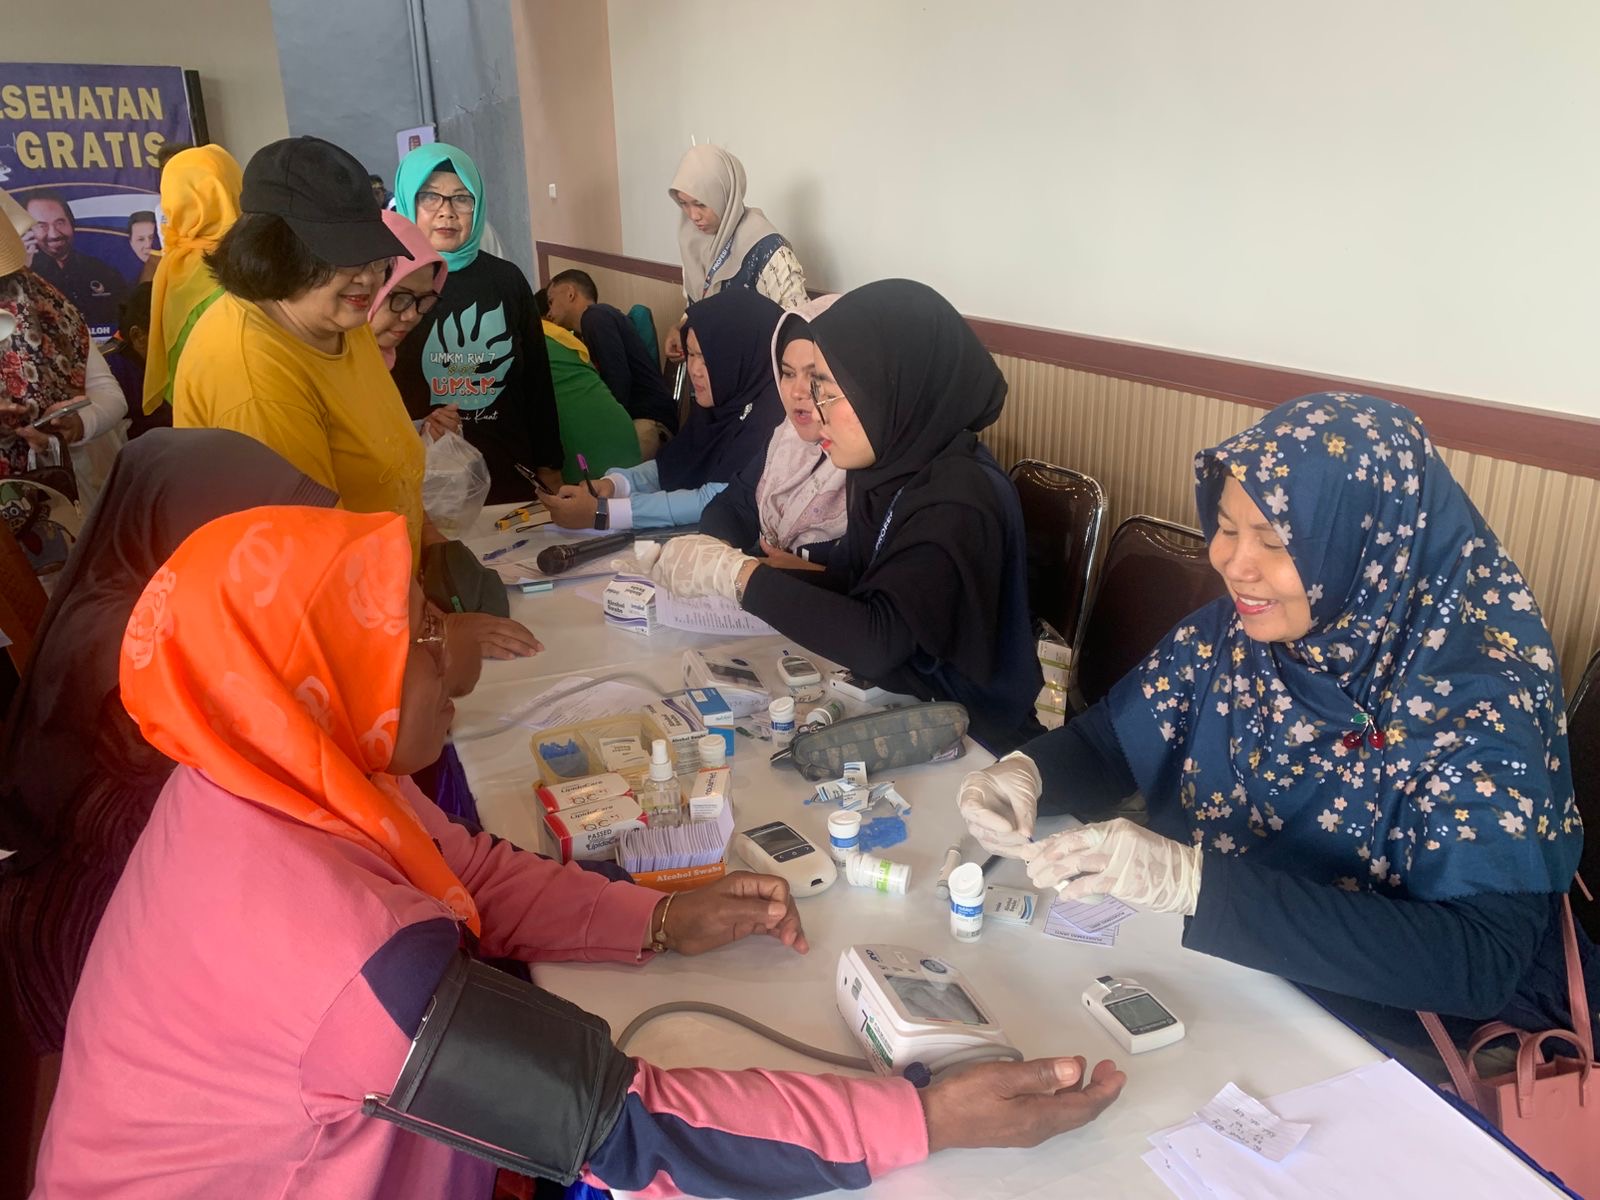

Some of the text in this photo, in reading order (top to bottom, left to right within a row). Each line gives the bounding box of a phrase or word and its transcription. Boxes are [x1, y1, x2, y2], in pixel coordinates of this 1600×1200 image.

[0, 85, 164, 121] SEHATAN
[16, 131, 166, 169] GRATIS
[430, 352, 496, 365] UMKM RW 7
[656, 865, 722, 883] Alcohol Swabs
